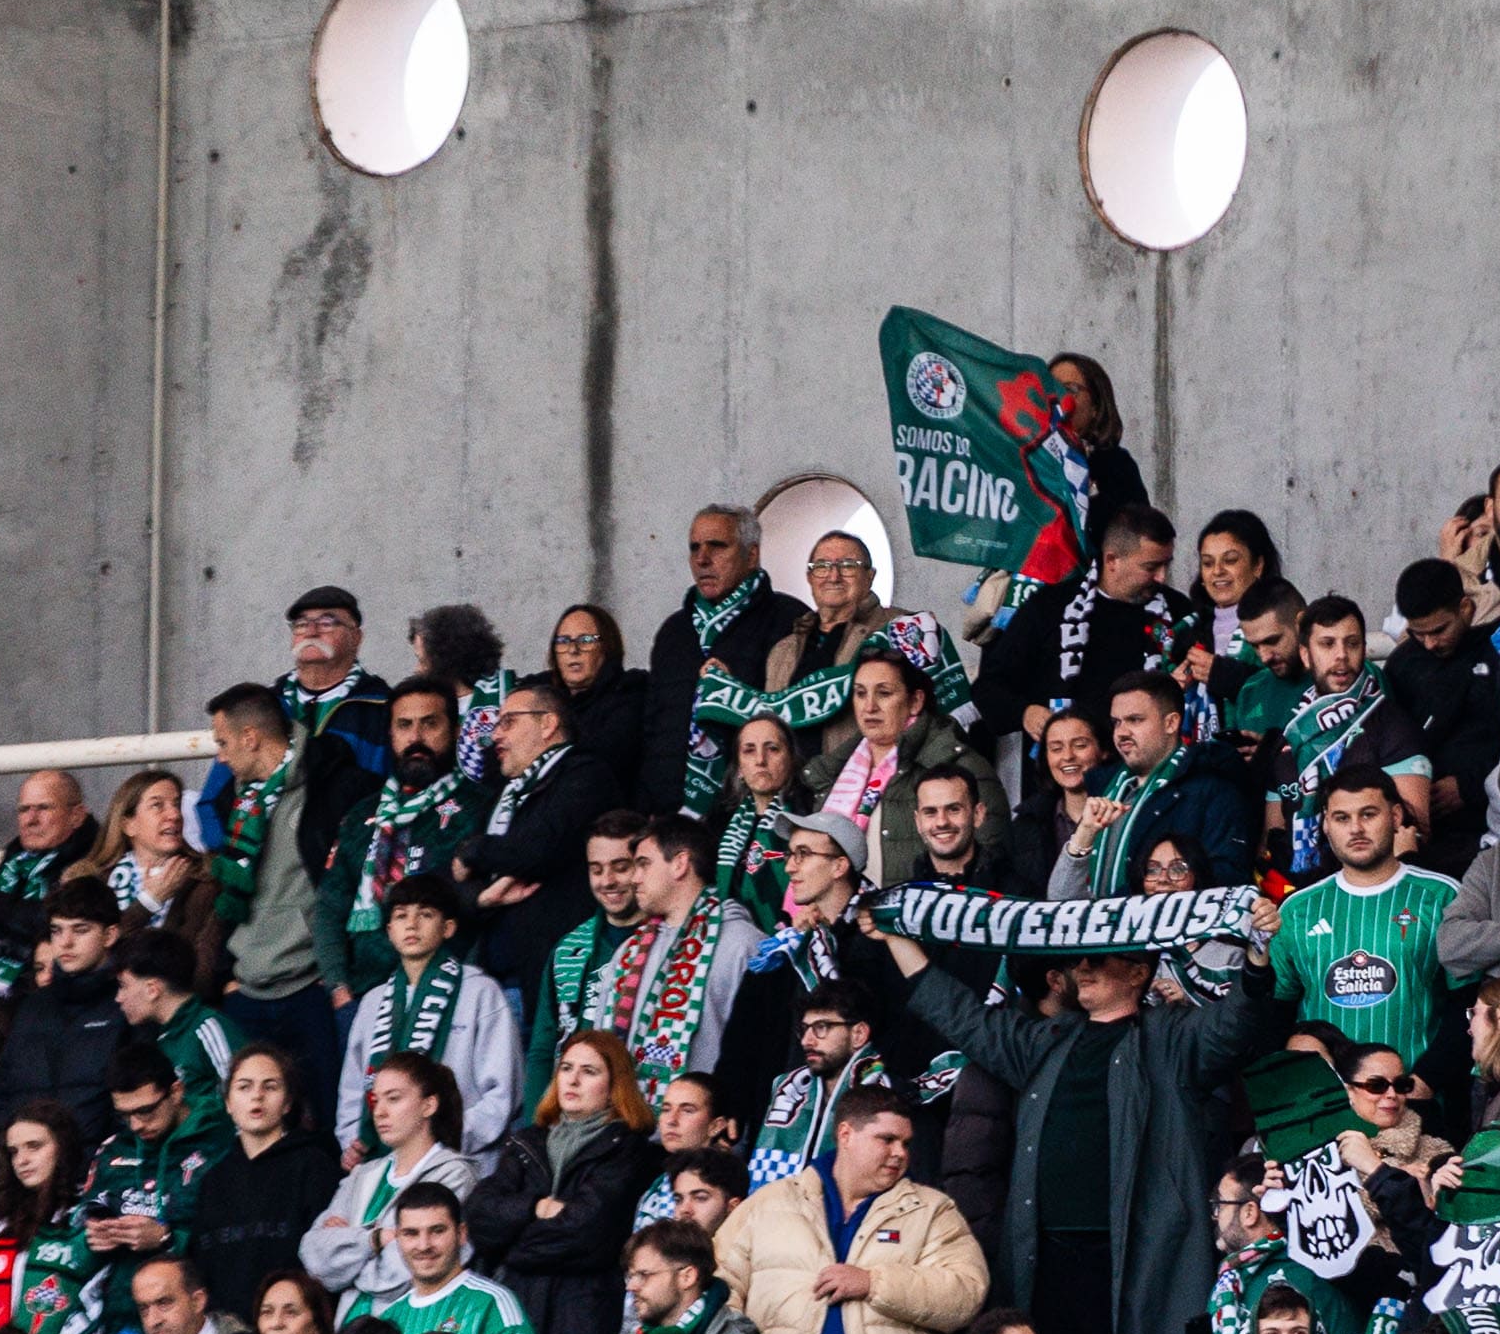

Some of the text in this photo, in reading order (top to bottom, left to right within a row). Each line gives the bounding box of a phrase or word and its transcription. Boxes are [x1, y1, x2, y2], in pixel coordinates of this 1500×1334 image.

[896, 424, 953, 454] SOMOS
[896, 452, 1020, 523] RACING
[1333, 965, 1386, 982] Estrella
[1333, 978, 1384, 995] Galicia
